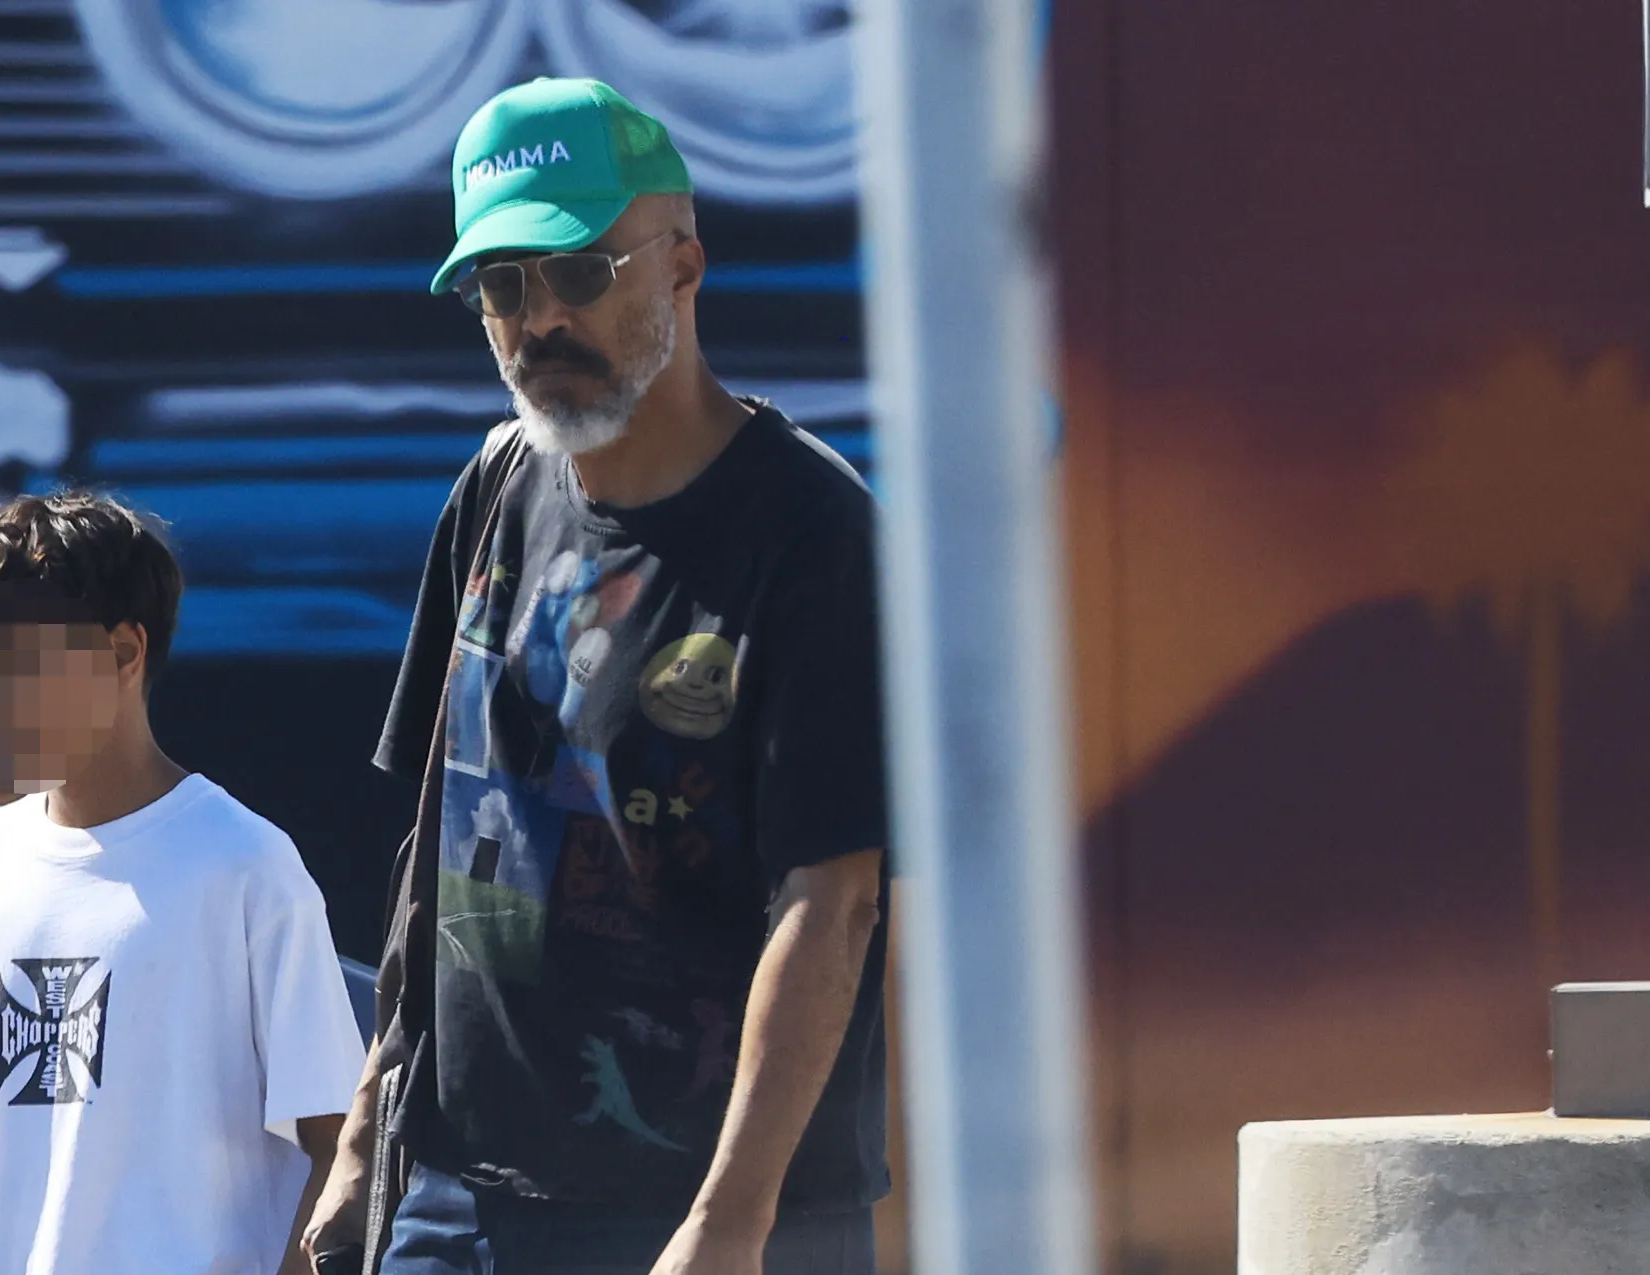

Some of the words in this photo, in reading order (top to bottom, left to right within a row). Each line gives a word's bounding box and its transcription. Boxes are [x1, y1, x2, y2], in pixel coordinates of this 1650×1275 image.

[462, 140, 572, 191] MOMMA
[623, 787, 659, 826] a
[41, 965, 73, 1019] WEST
[0, 1000, 103, 1065] CHOPPERS
[38, 1043, 64, 1098] COAST
